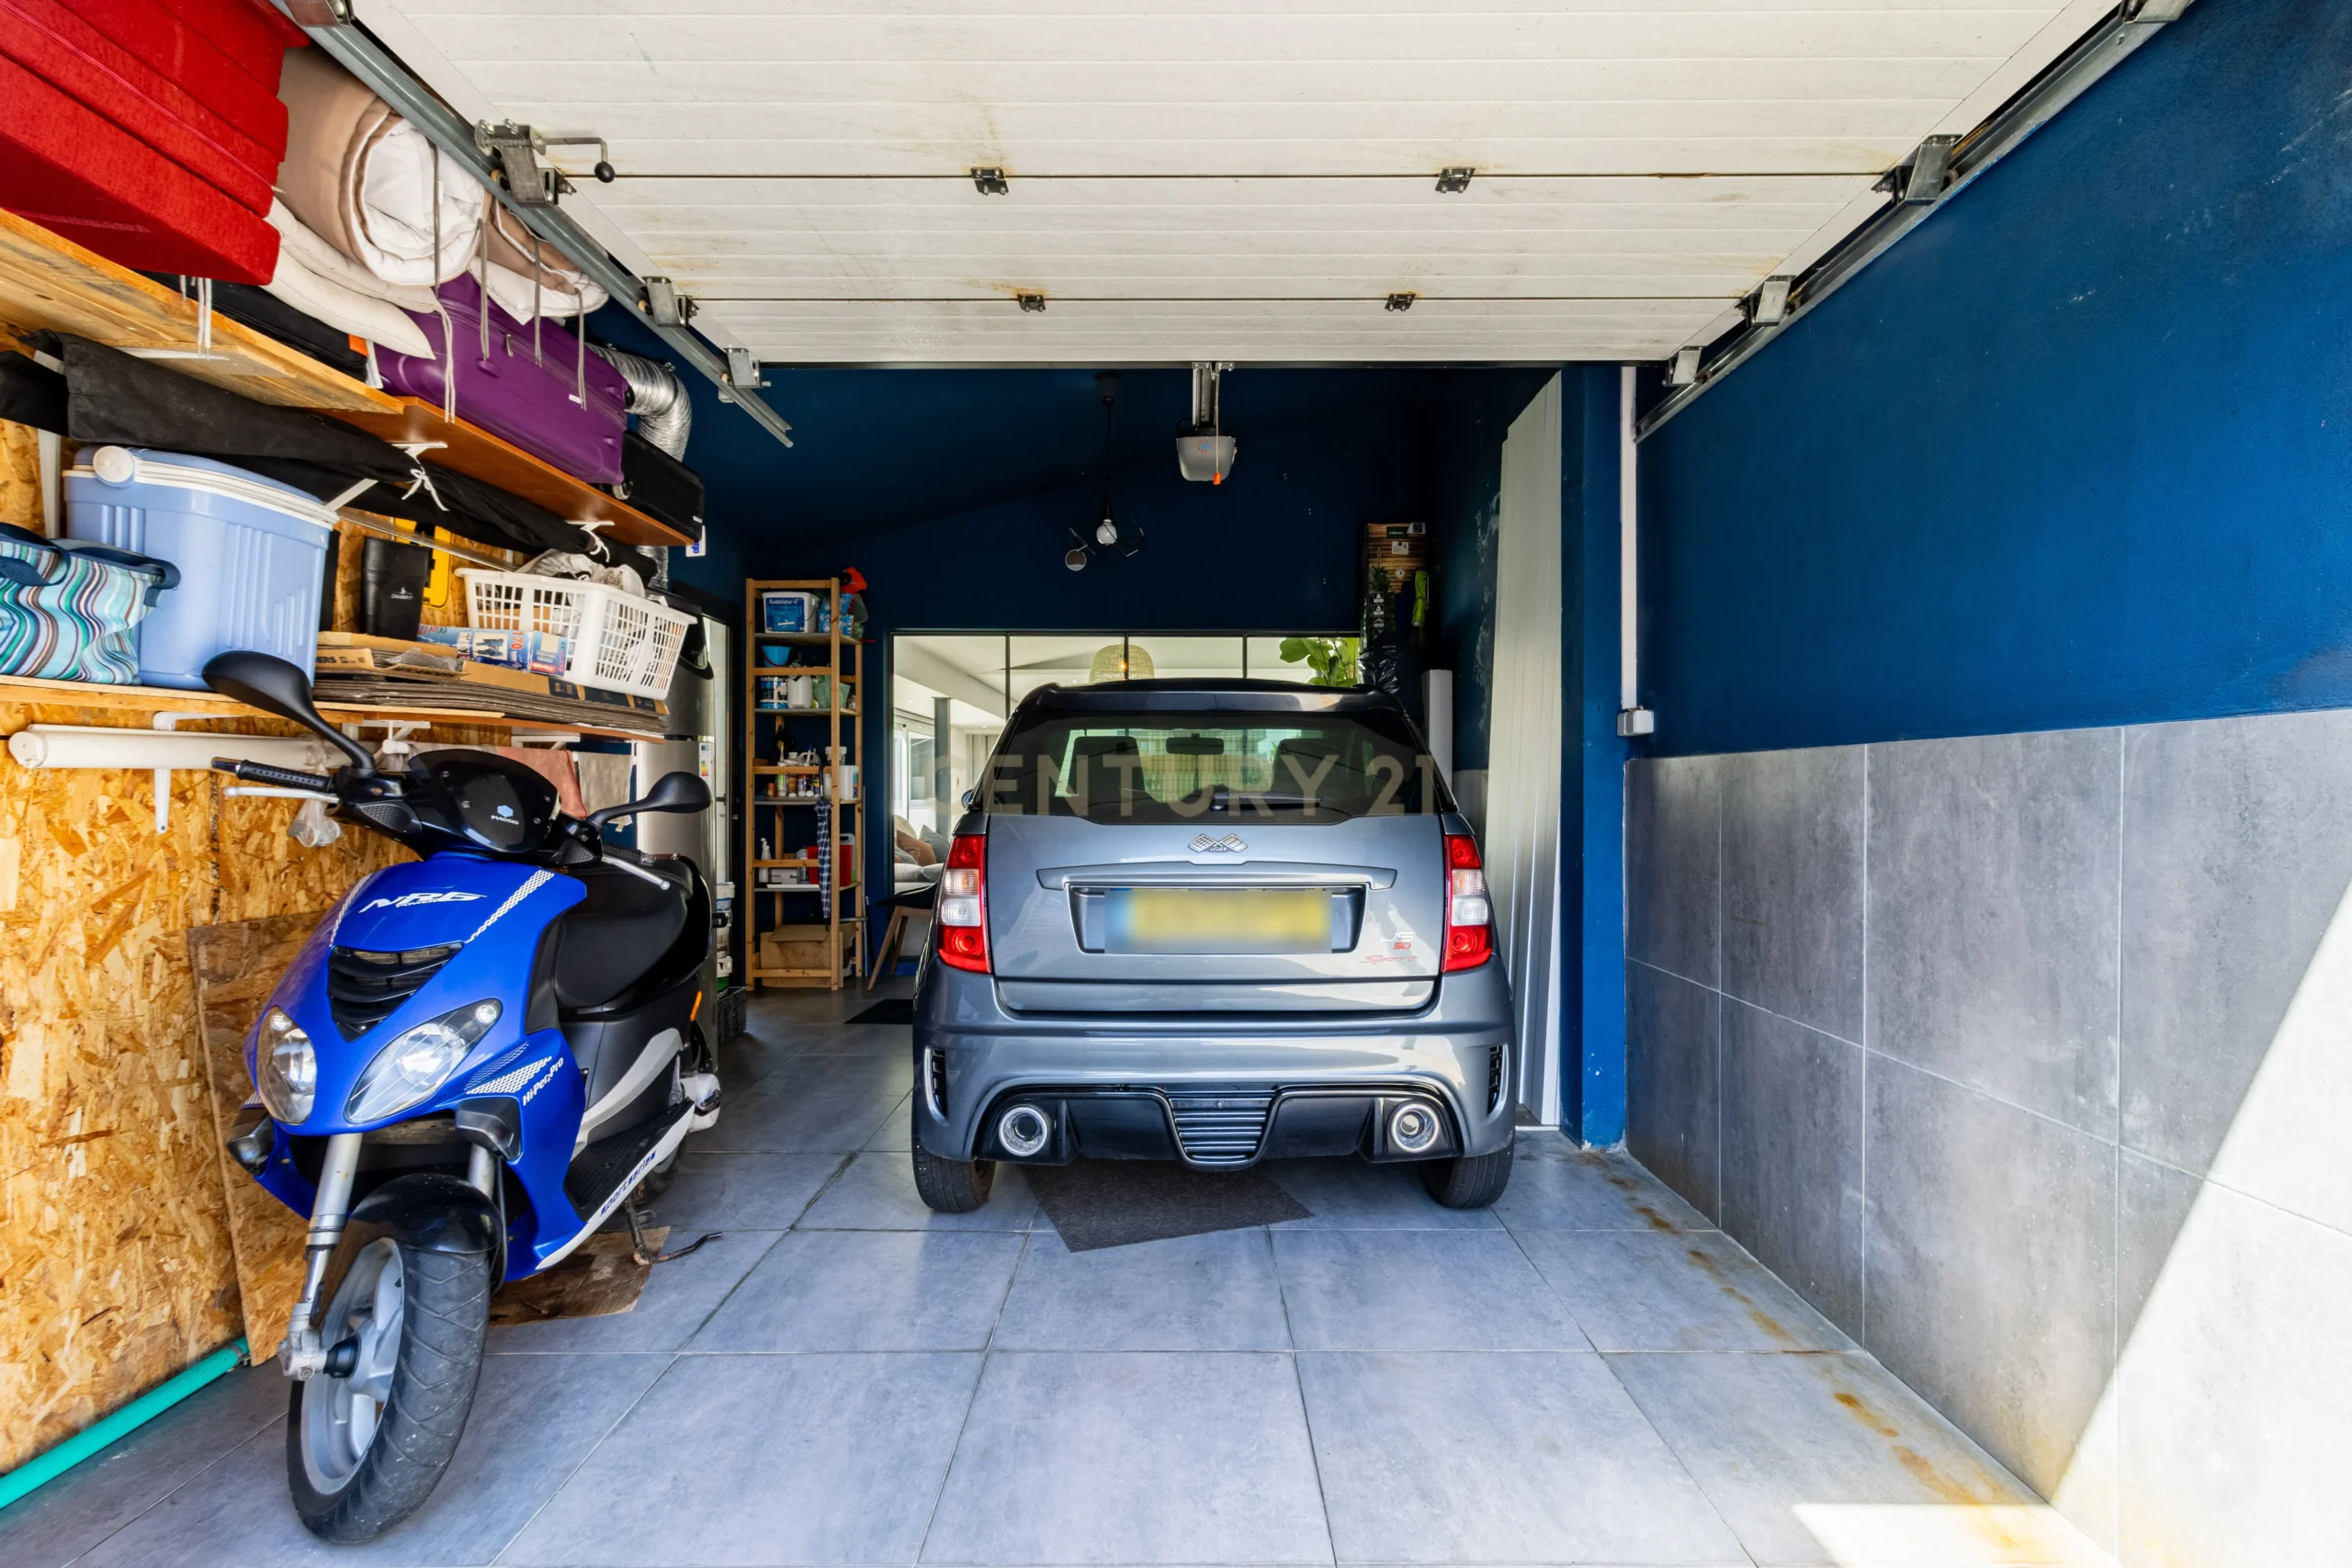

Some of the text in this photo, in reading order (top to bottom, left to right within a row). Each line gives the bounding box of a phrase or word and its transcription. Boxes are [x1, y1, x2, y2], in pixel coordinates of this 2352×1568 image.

[491, 815, 519, 825] PIAGGIO
[358, 892, 487, 913] NRG
[1379, 931, 1415, 942] JS
